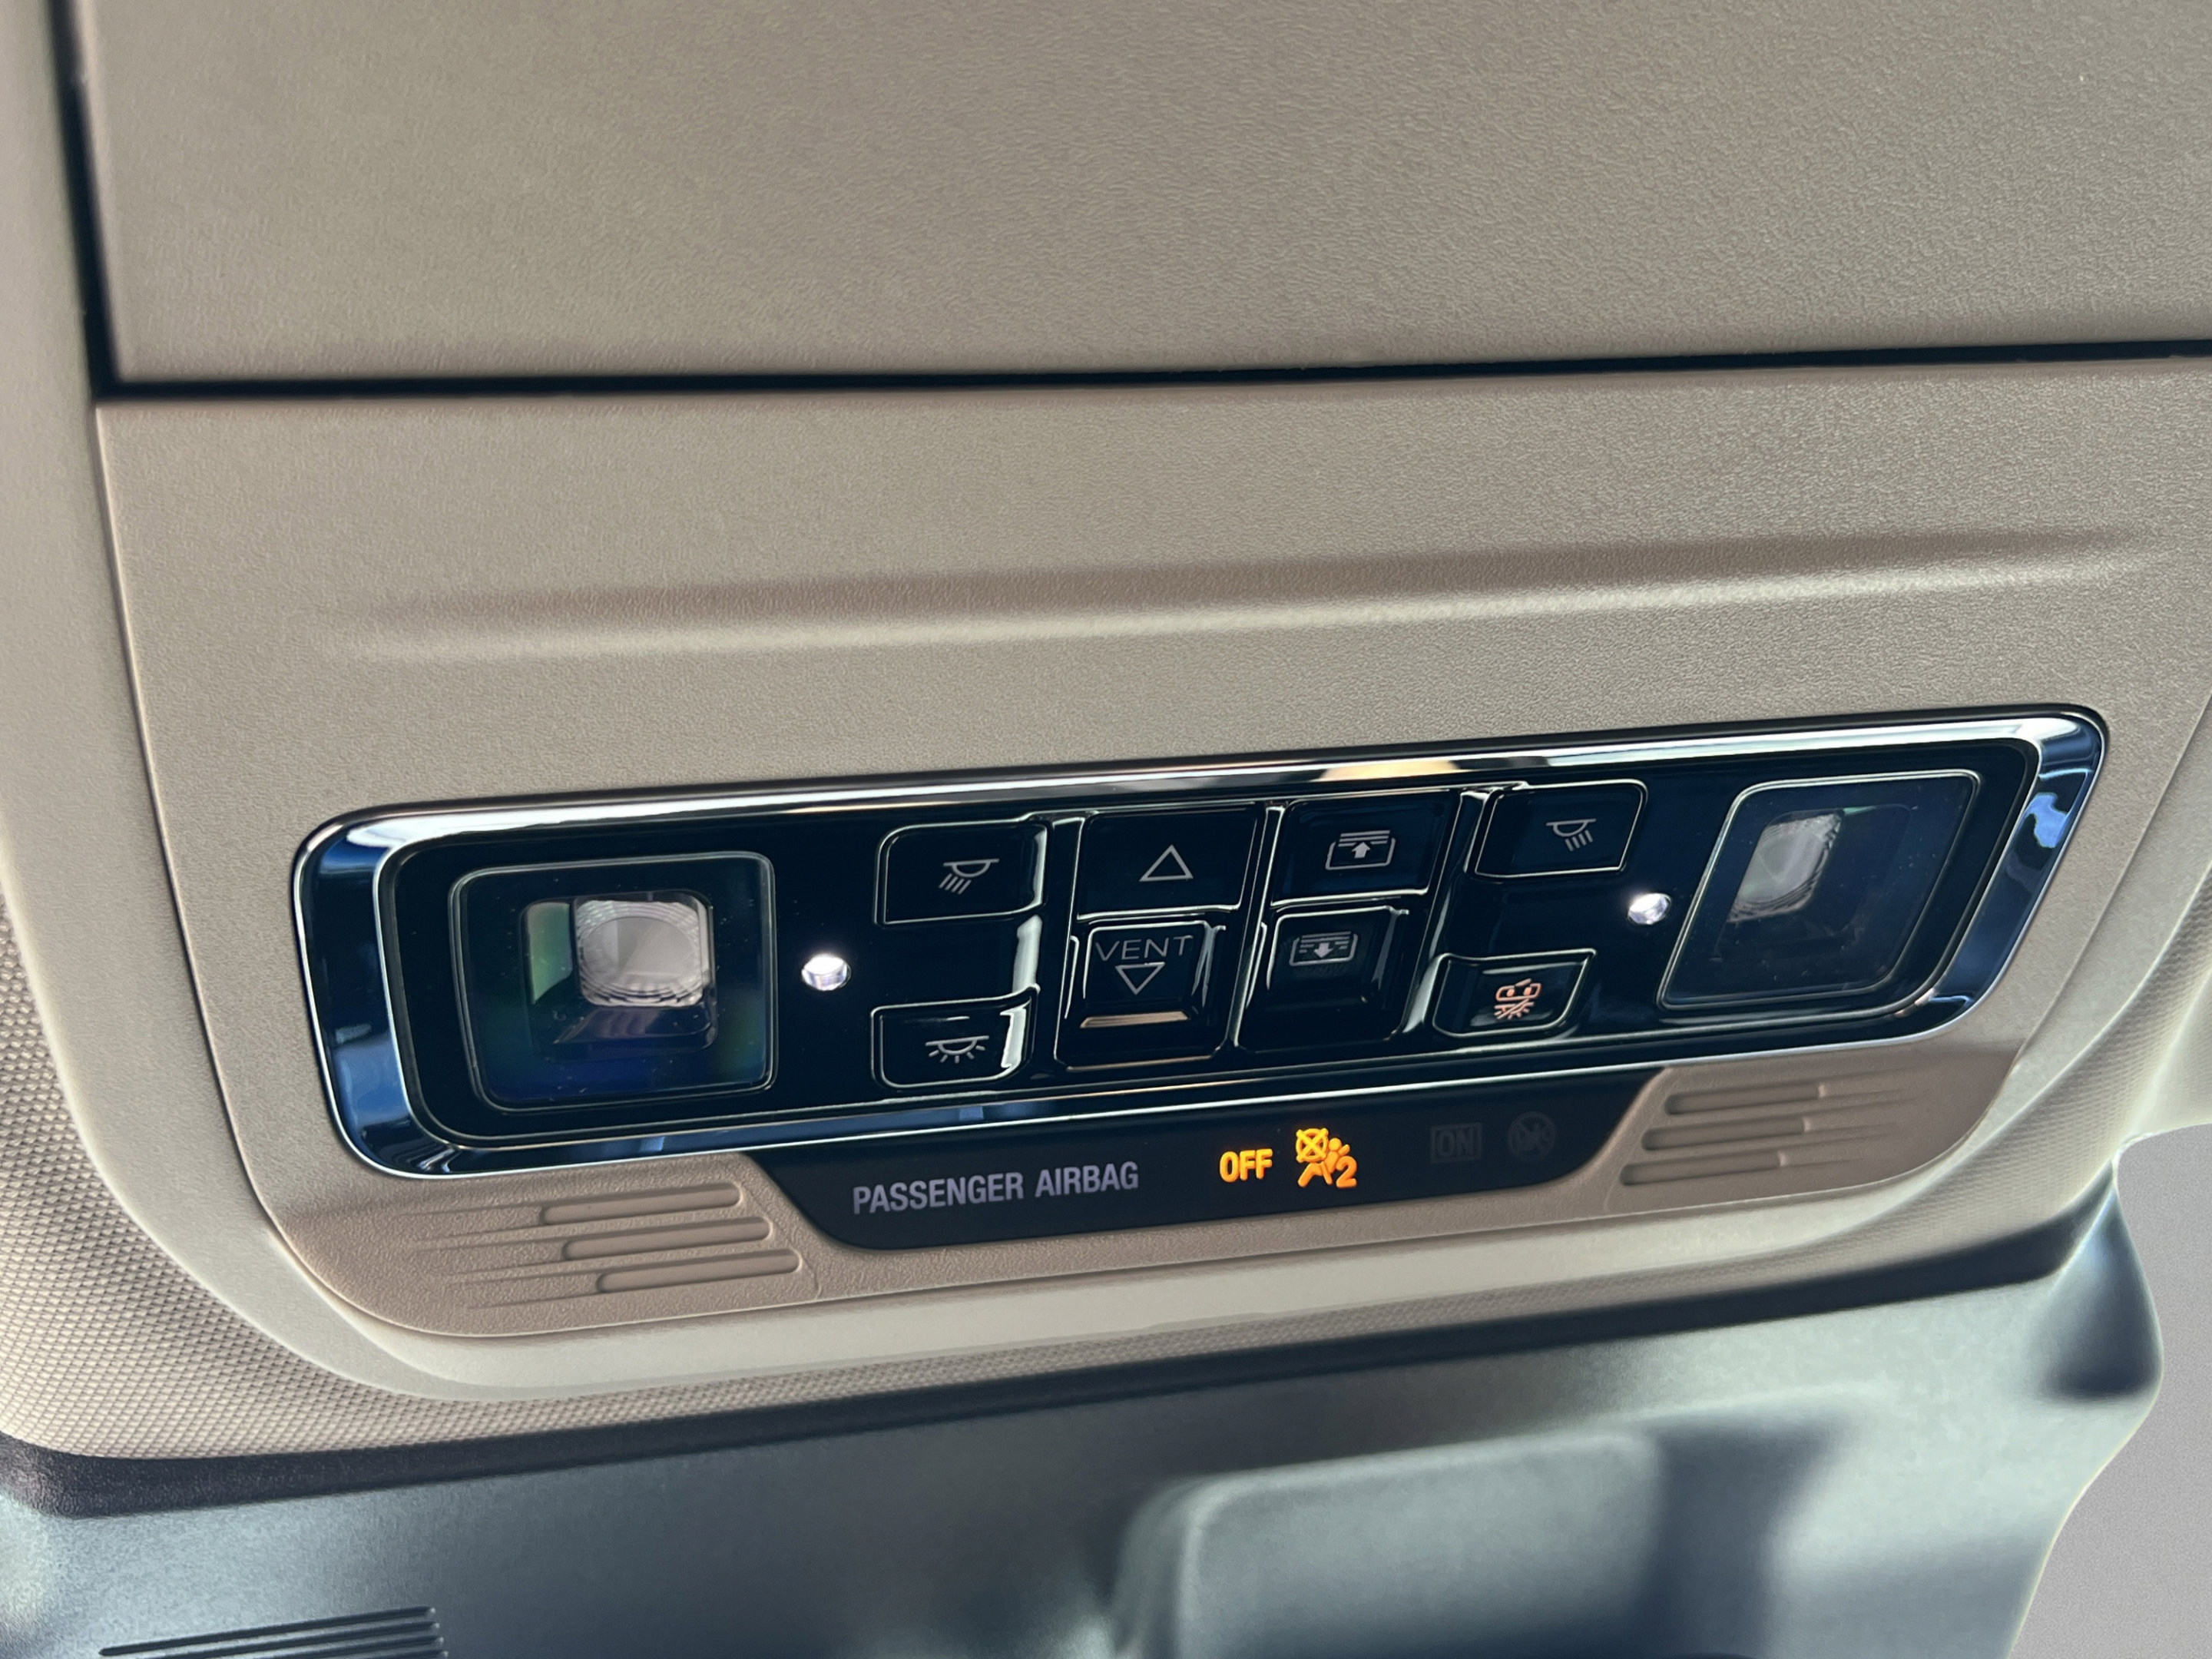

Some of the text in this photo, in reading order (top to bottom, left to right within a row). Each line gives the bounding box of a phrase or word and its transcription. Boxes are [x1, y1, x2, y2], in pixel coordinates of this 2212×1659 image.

[1095, 935, 1194, 962] VENT
[1437, 1127, 1475, 1157] ON
[1220, 1148, 1273, 1183] OFF
[1336, 1155, 1358, 1188] 2
[853, 1161, 1139, 1215] PASSENGER AIRBAG
